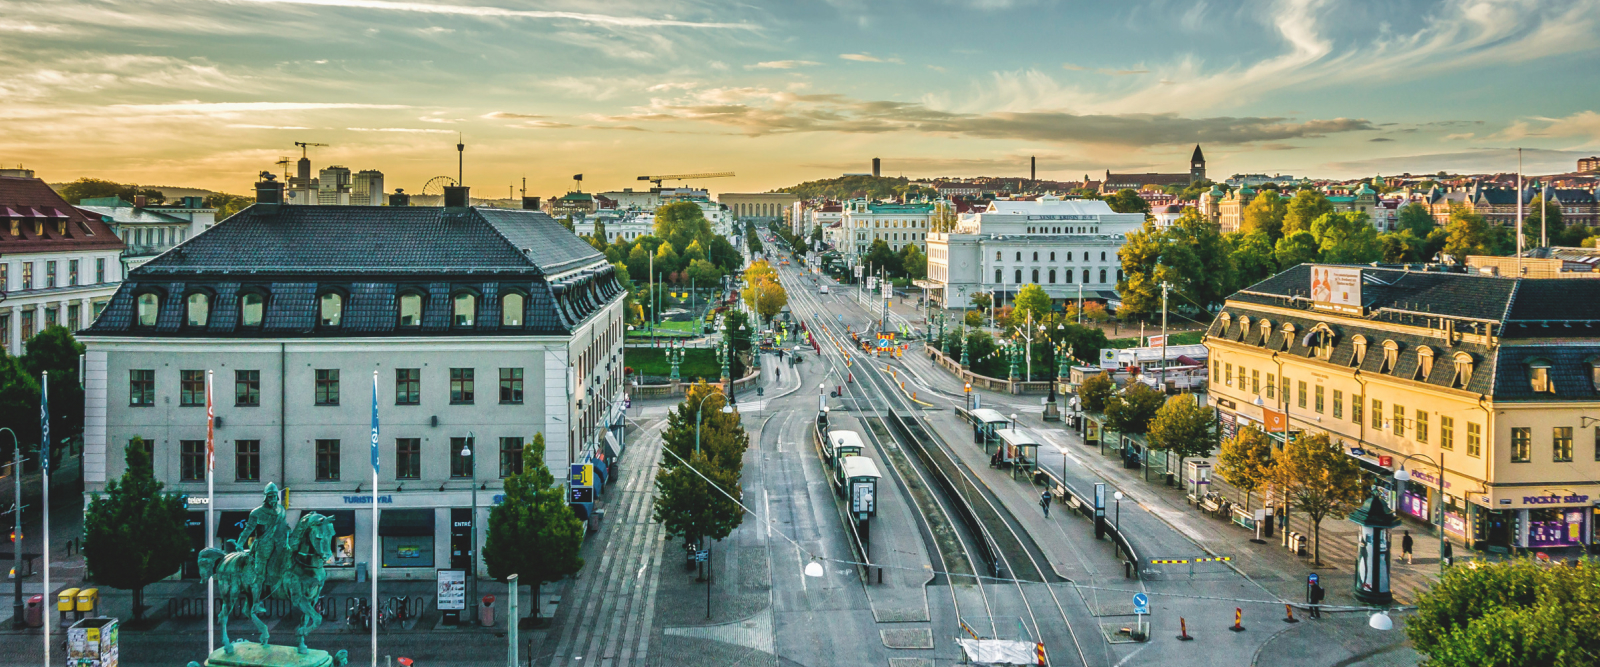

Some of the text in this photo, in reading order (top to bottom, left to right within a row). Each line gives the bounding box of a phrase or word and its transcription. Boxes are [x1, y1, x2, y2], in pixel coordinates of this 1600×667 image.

[343, 494, 393, 504] TURISTYRÅ
[1522, 495, 1562, 504] POCKET
[1564, 495, 1589, 503] SHOP
